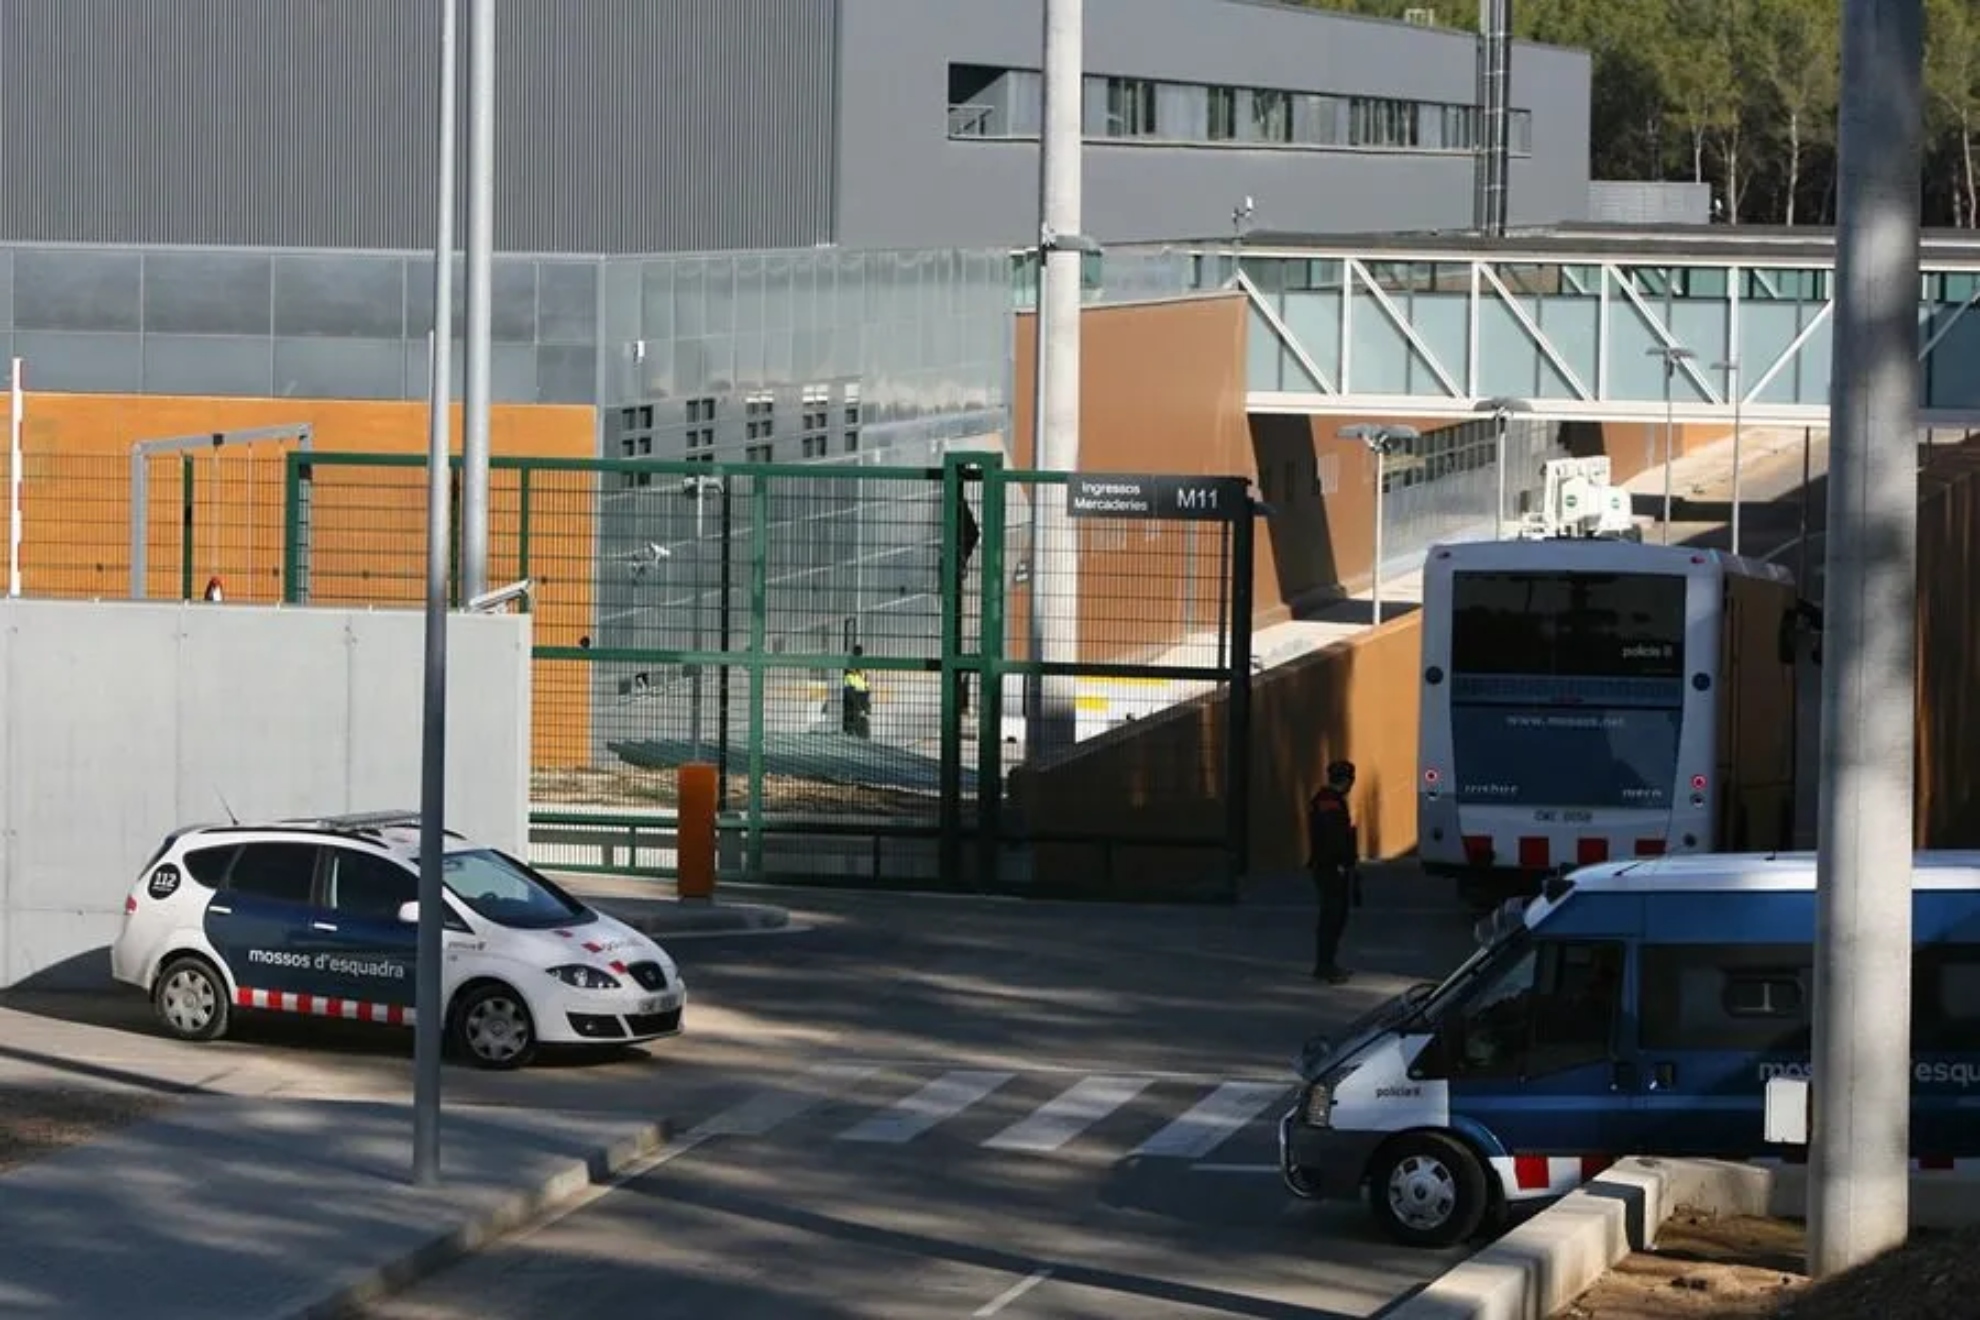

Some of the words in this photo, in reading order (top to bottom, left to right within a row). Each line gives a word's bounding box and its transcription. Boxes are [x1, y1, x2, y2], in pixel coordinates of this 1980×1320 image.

[1081, 481, 1140, 496] Ingressos
[1074, 497, 1148, 511] Mercaderies
[1176, 488, 1217, 509] M11
[153, 871, 177, 888] 112
[248, 949, 311, 969] mossos
[314, 951, 405, 979] d'esquadra
